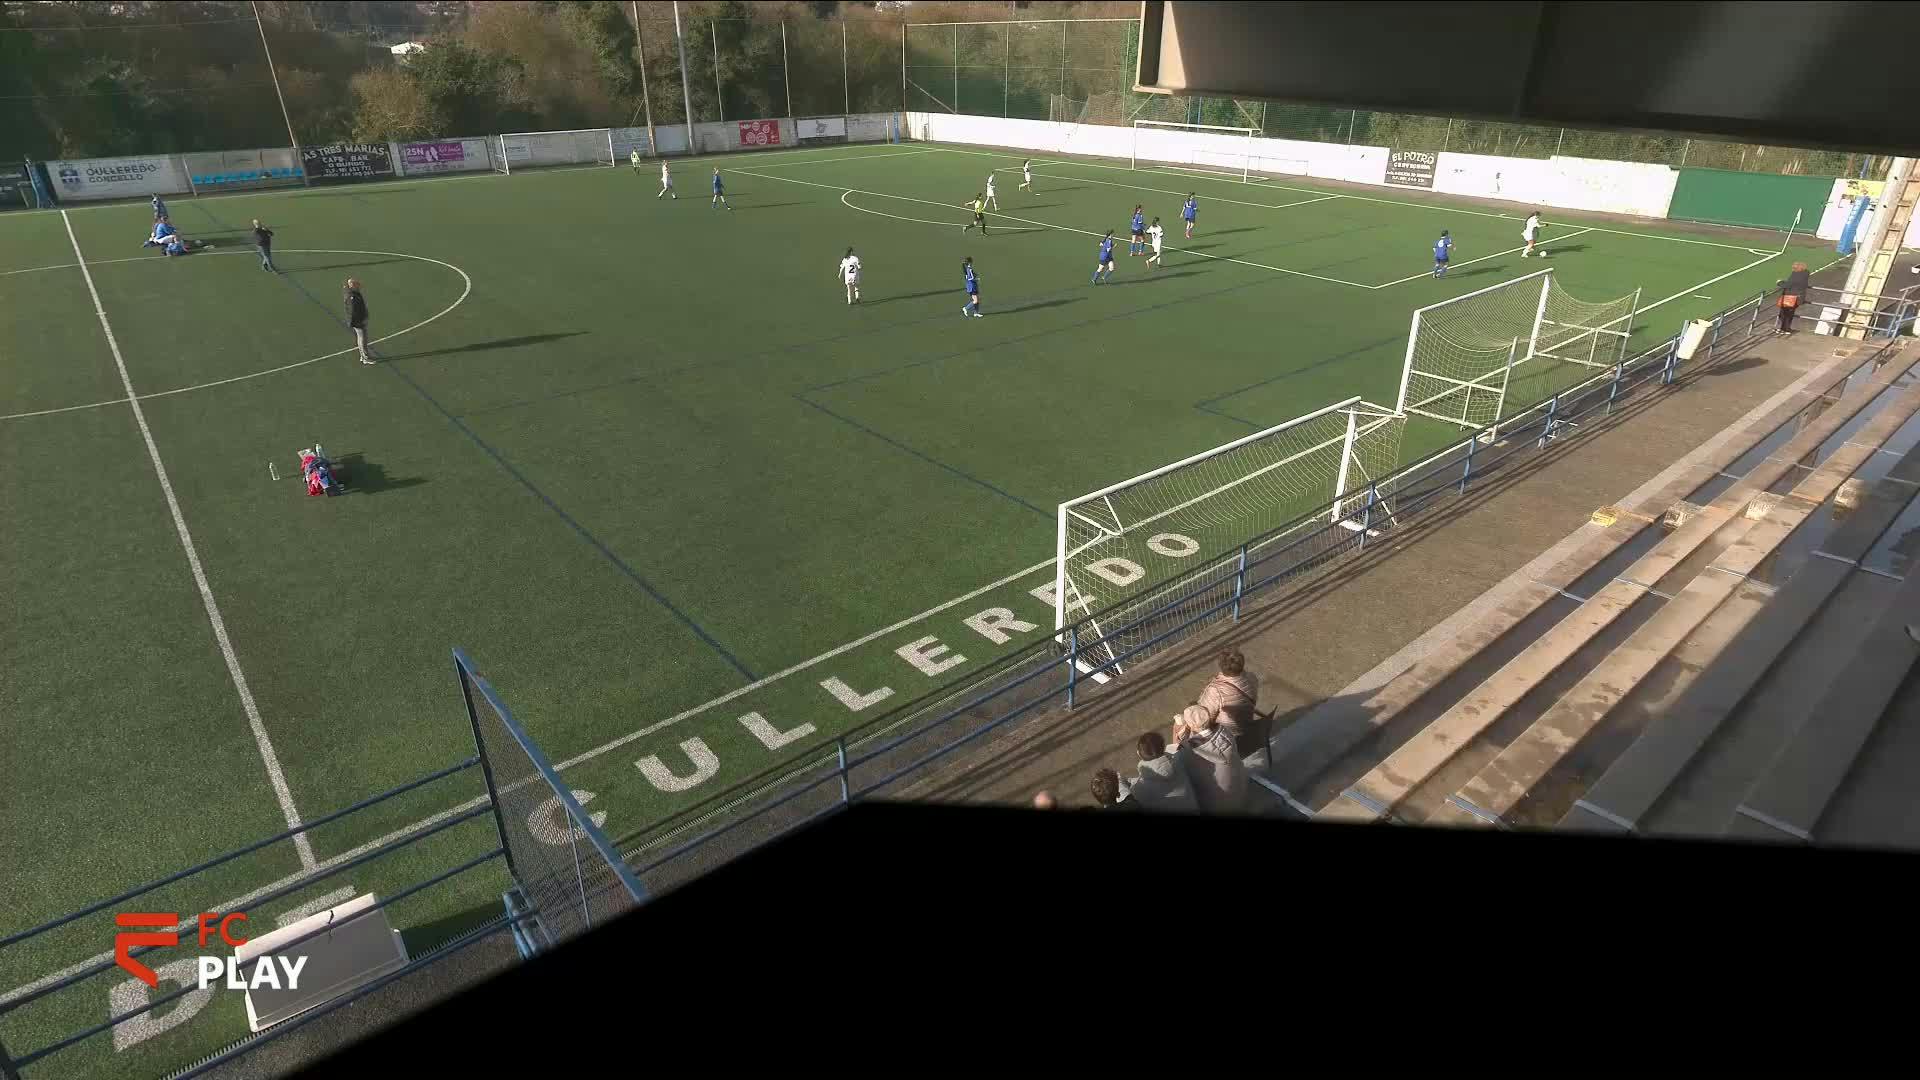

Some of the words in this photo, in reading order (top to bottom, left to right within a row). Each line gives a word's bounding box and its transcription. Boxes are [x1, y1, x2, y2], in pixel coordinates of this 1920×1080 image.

[303, 150, 318, 161] AS
[319, 145, 341, 156] TRES
[344, 144, 385, 155] MARIAS
[351, 154, 369, 162] BAR
[1403, 152, 1434, 164] POTRO
[848, 244, 855, 253] 2
[527, 532, 1199, 845] CULLEREDO
